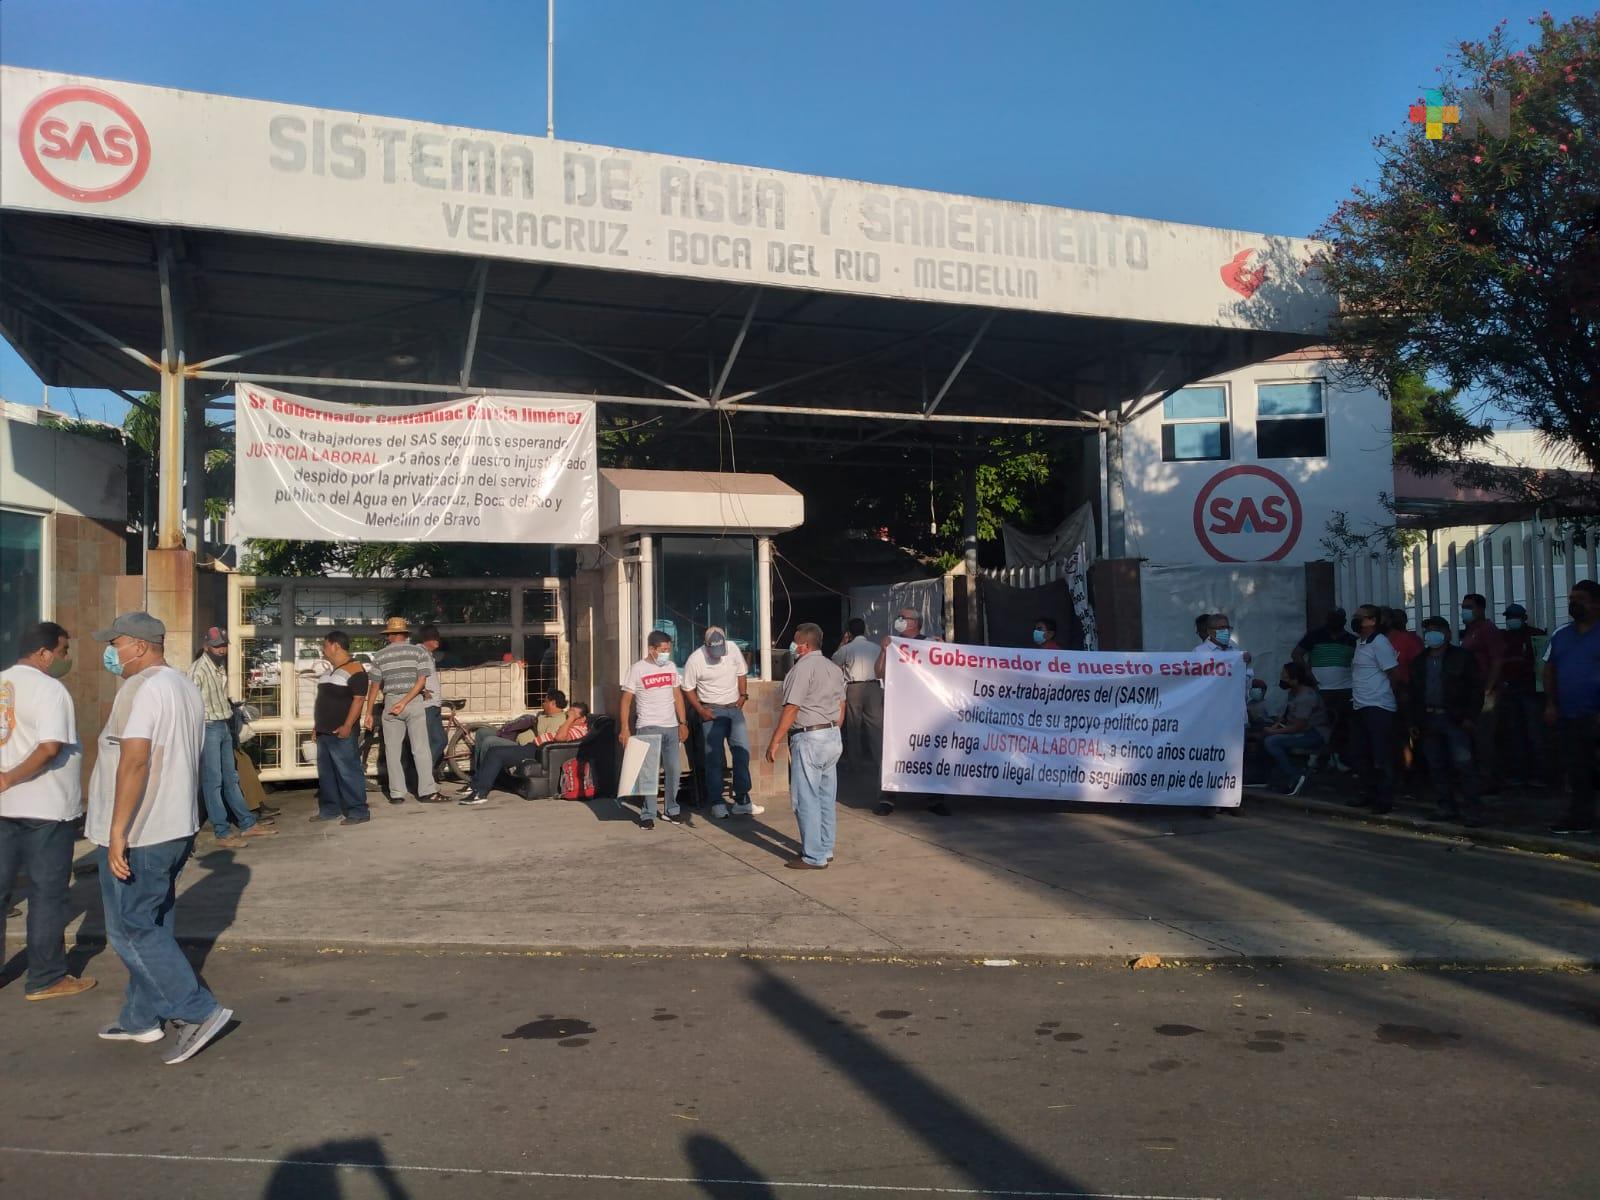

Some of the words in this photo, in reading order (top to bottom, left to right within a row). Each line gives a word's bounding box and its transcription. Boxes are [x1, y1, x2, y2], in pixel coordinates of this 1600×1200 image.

[40, 117, 133, 166] SAS
[269, 114, 535, 200] SISTEMA
[563, 151, 633, 212] DE
[659, 165, 786, 231] AGUA
[812, 184, 837, 236] Y
[860, 188, 1149, 271] SANEAMIENTO
[442, 202, 629, 257] VERACRUZ
[668, 229, 752, 271] BOCA
[768, 240, 820, 277] DEL
[835, 248, 881, 283] RIO
[914, 256, 1038, 300] MEDELLIN
[273, 398, 372, 424] Gobernador
[522, 406, 583, 425] Jiménez
[267, 424, 291, 439] Los
[300, 429, 382, 448] trabajadores
[386, 434, 406, 447] del
[410, 432, 437, 446] SAS
[441, 435, 500, 449] seguimos
[504, 436, 568, 450] esperando
[246, 442, 308, 462] JUSTICIA
[312, 448, 379, 464] LABORAL
[399, 452, 407, 464] 5
[410, 452, 440, 466] años
[444, 453, 459, 466] de
[294, 467, 348, 486] despido
[351, 472, 374, 487] por
[379, 470, 389, 484] la
[478, 472, 496, 486] del
[329, 491, 349, 505] del
[353, 491, 387, 509] Agua
[391, 494, 407, 505] en
[412, 492, 470, 507] Veracruz,
[474, 493, 505, 507] Boca
[510, 494, 528, 508] del
[555, 498, 562, 512] y
[1209, 495, 1288, 534] SAS
[424, 513, 439, 526] de
[444, 512, 480, 527] Bravo
[898, 644, 922, 664] Sr.
[929, 647, 1042, 672] Gobernador
[1048, 656, 1071, 674] de
[1078, 659, 1153, 675] nuestro
[1160, 657, 1233, 677] estado:
[973, 679, 995, 698] Los
[999, 683, 1091, 705] ex-trabajadores
[1094, 685, 1113, 703] del
[1115, 686, 1162, 709] (SASM),
[957, 706, 1024, 726] solicitamos
[1028, 709, 1042, 727] de
[1046, 715, 1061, 728] su
[1064, 714, 1100, 734] apoyo
[1104, 713, 1148, 735] político
[1152, 717, 1179, 736] para
[909, 732, 931, 751] que
[934, 735, 948, 749] se
[951, 731, 979, 755] haga
[983, 732, 1038, 753] JUSTICIA
[1042, 736, 1106, 760] LABORAL,
[1110, 744, 1117, 757] a
[1121, 741, 1153, 759] cinco
[1157, 742, 1185, 761] años
[1189, 744, 1225, 762] cuatro
[895, 759, 932, 776] meses
[936, 758, 950, 776] de
[954, 761, 999, 779] nuestro
[1002, 761, 1035, 785] ilegal
[1039, 764, 1085, 787] despido
[1089, 768, 1147, 789] seguimos
[1151, 775, 1165, 787] en
[1167, 770, 1186, 792] pie
[1189, 771, 1203, 788] de
[1207, 770, 1237, 789] lucha
